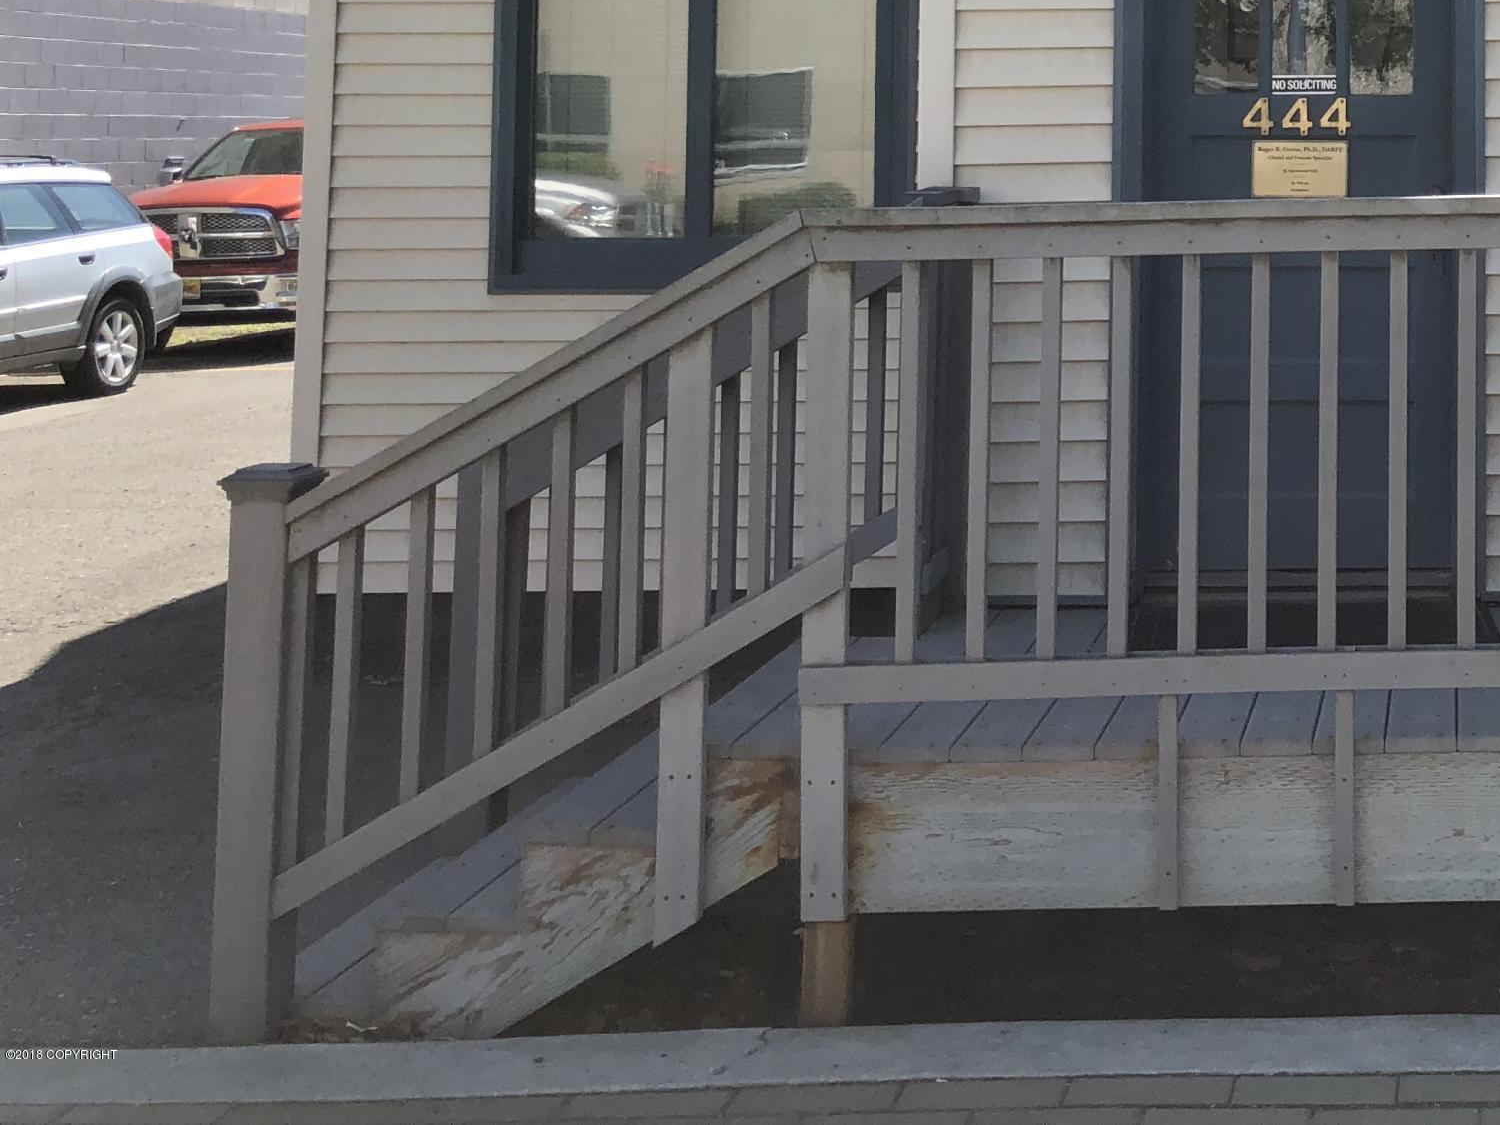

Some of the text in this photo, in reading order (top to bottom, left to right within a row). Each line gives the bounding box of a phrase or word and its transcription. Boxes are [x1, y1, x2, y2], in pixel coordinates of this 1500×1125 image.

[1271, 79, 1337, 90] NO SOLICITING
[1242, 97, 1352, 136] 444
